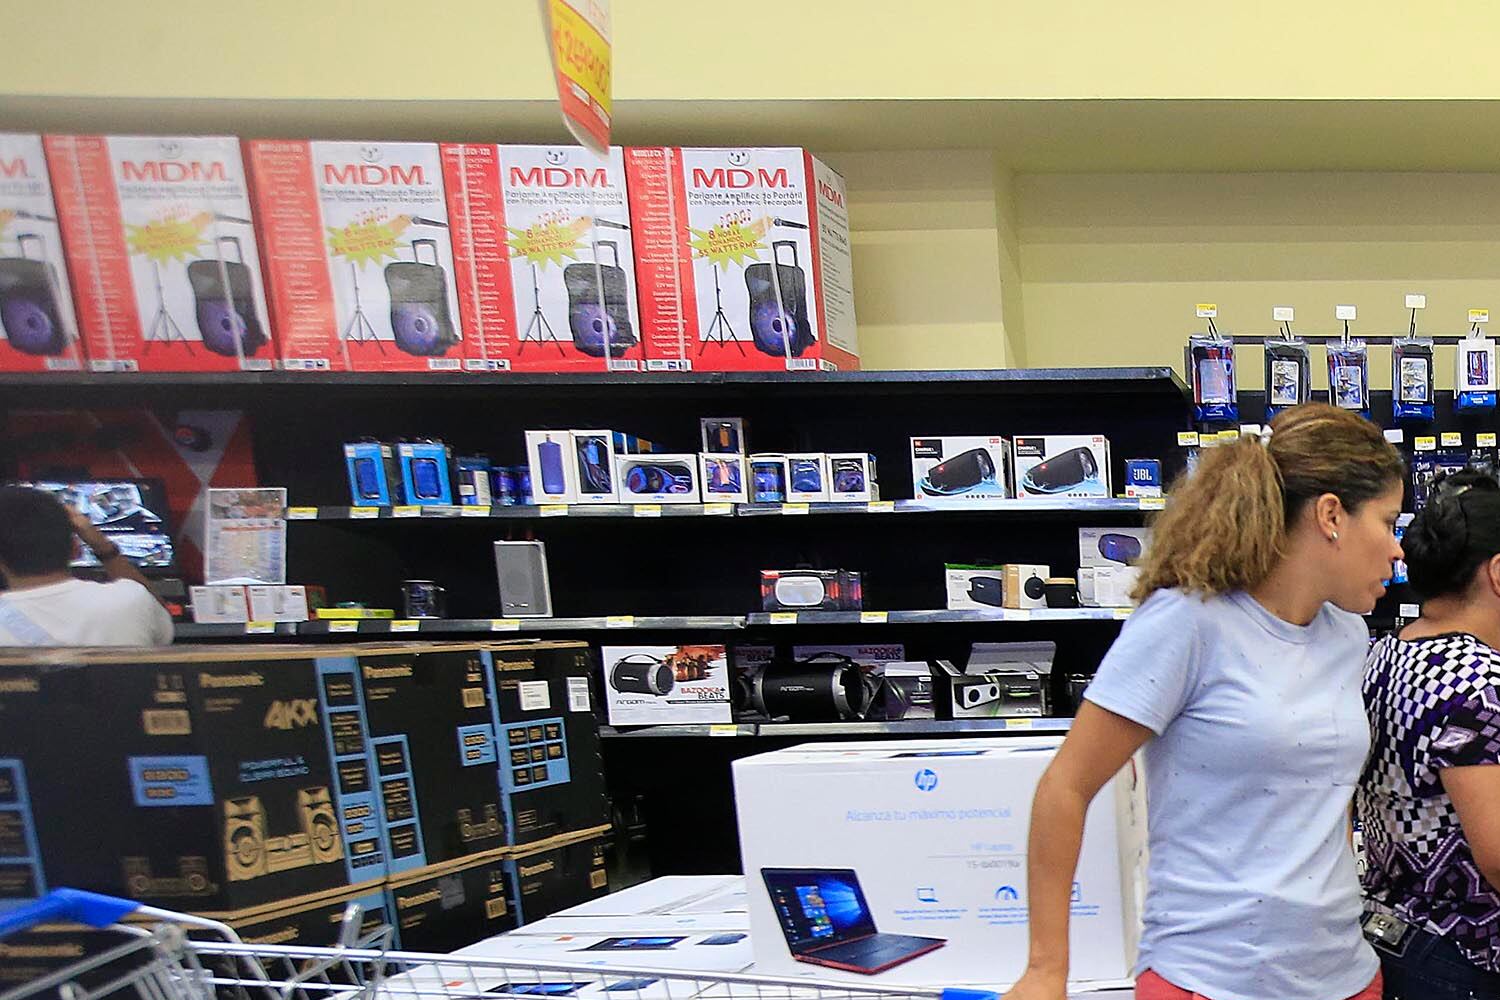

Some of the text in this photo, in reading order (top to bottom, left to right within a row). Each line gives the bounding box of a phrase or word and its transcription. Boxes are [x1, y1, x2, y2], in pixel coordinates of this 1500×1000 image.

[121, 160, 226, 183] MDM
[323, 164, 424, 186] MDM
[510, 167, 608, 188] MDM
[692, 168, 789, 189] MDM
[708, 229, 716, 240] 8
[711, 243, 739, 255] WATTS
[740, 240, 757, 250] RMS
[1133, 468, 1152, 481] JBL
[263, 698, 319, 730] AKX
[846, 809, 893, 822] Alcanza
[894, 811, 907, 821] tu
[959, 806, 1012, 821] potencial
